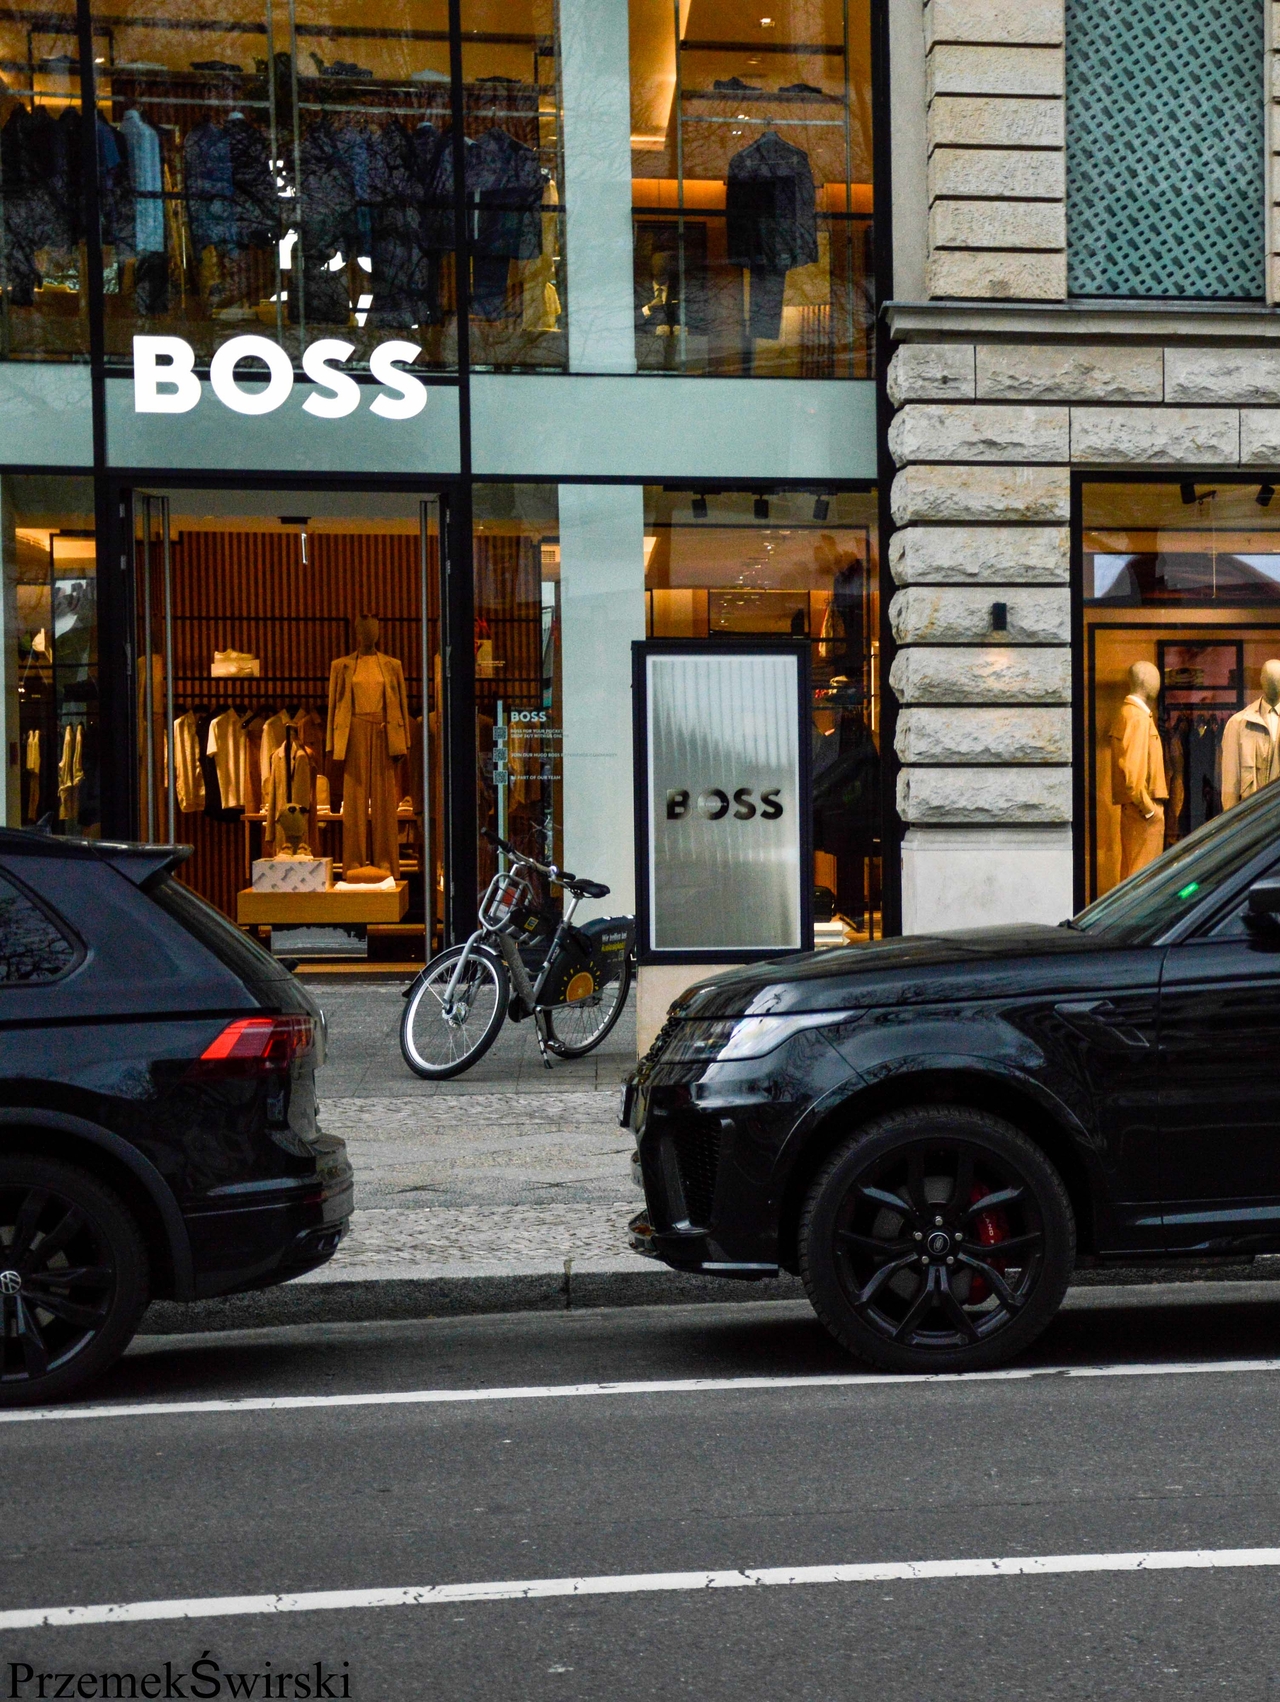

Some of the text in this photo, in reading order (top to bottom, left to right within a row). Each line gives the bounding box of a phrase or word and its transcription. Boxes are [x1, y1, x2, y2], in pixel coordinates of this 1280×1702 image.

[134, 336, 428, 420] BOSS
[511, 711, 547, 722] BOSS
[666, 787, 784, 820] BOSS
